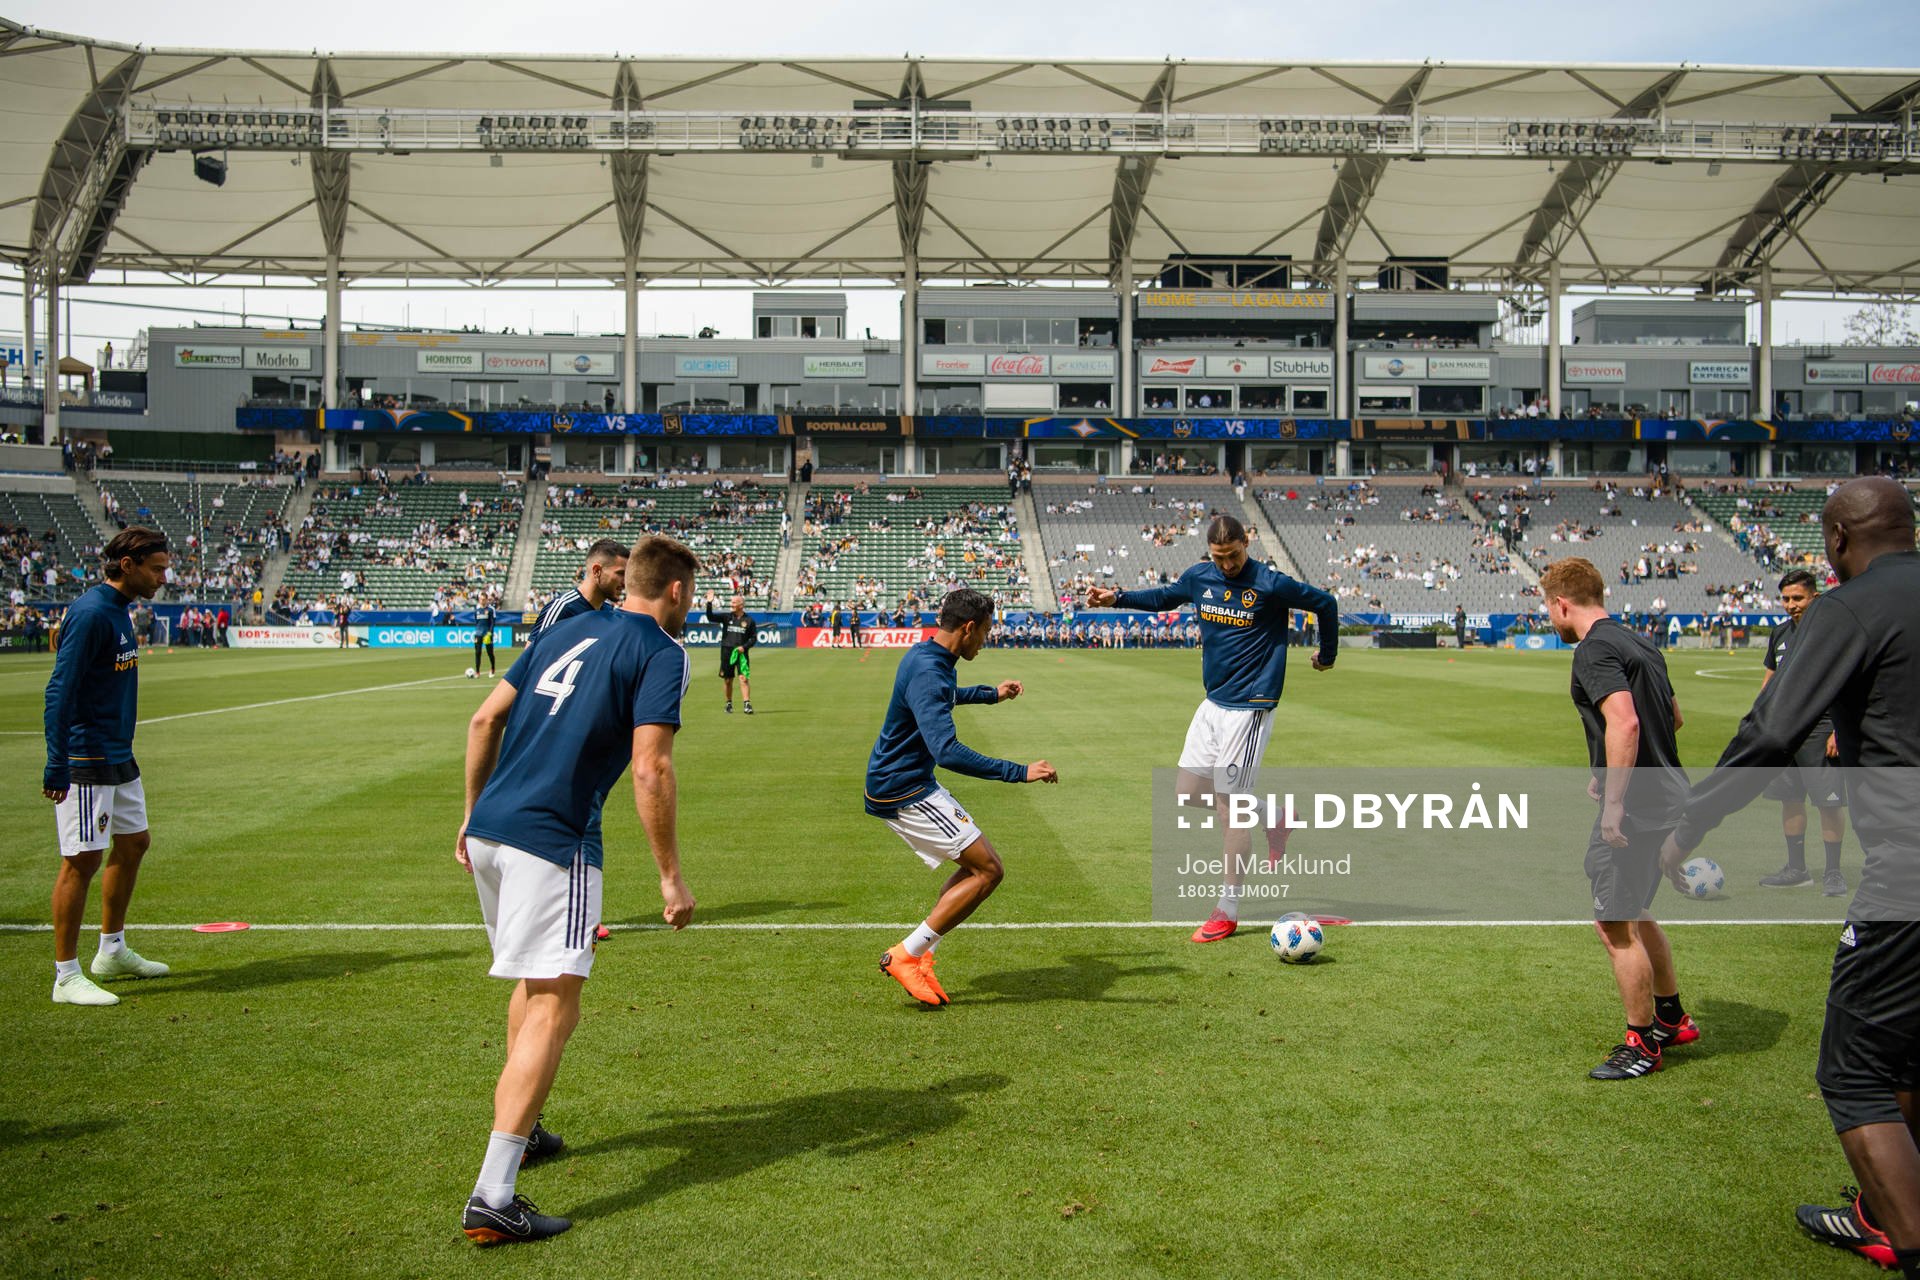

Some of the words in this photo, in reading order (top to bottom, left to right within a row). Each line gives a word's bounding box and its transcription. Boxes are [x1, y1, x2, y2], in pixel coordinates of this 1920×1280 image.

[1147, 293, 1197, 306] HOME
[1254, 294, 1328, 307] GALAXY
[256, 352, 299, 367] Modelo
[425, 355, 472, 364] HORNITOS
[505, 359, 546, 368] TOYOTA
[936, 360, 970, 369] Frontier
[1439, 361, 1455, 369] SAN
[1457, 361, 1488, 369] MANUEL
[1273, 360, 1329, 374] StubHub
[1584, 368, 1623, 376] TOYOTA
[605, 415, 626, 431] VS
[806, 421, 858, 431] FOOTBALL
[860, 422, 887, 431] CLUB
[1225, 421, 1246, 435] VS
[1223, 590, 1232, 602] 9
[1200, 603, 1254, 620] HERBALIFE
[1201, 611, 1253, 627] NUTRITION
[238, 630, 270, 639] BOB'S
[378, 629, 434, 644] alcatel
[534, 638, 599, 715] 4
[1226, 763, 1239, 784] 9
